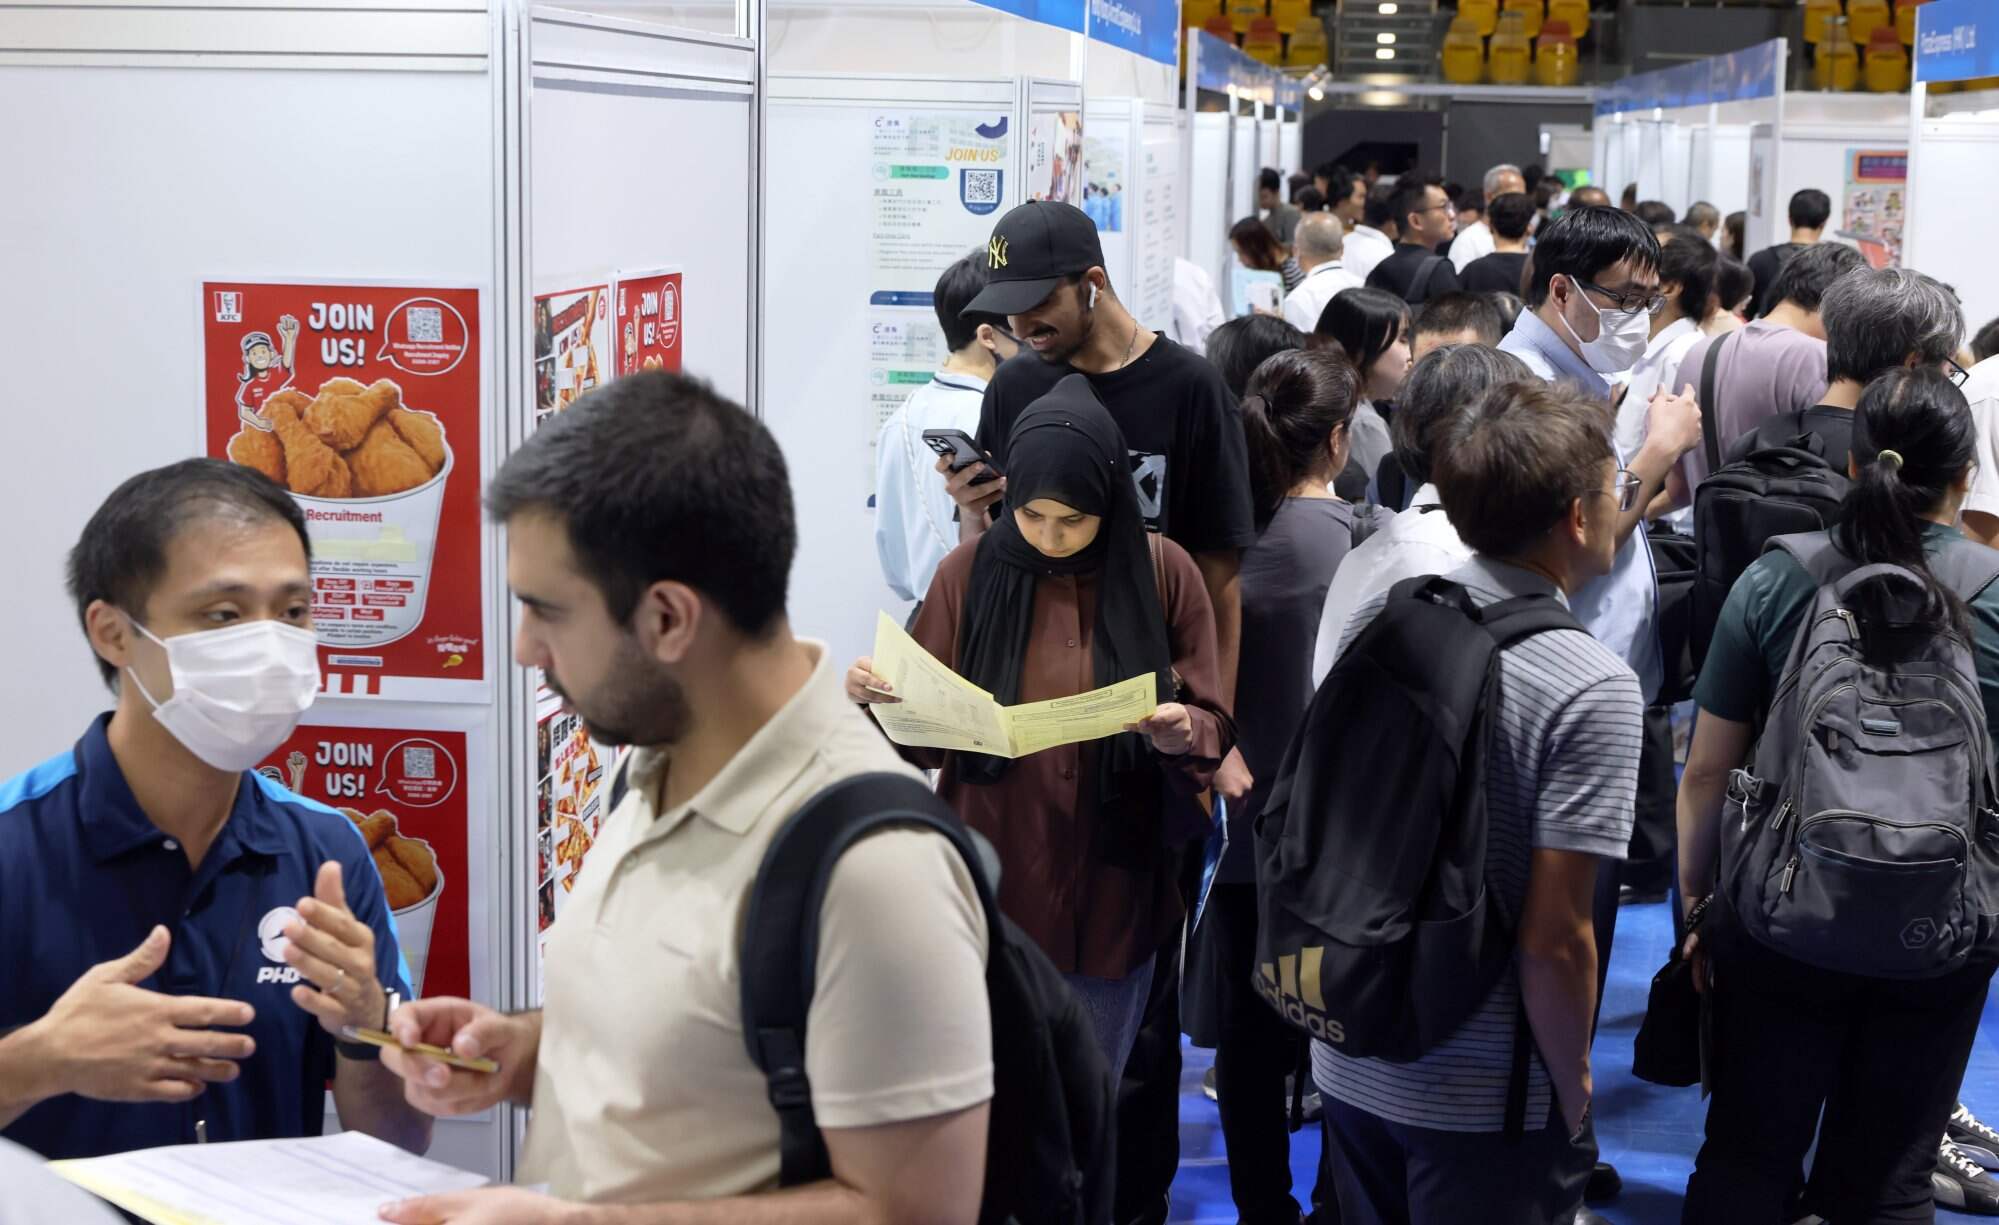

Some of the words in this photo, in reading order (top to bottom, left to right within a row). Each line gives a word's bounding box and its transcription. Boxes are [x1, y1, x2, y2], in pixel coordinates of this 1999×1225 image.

[945, 148, 977, 161] JOIN
[980, 149, 999, 162] US
[988, 235, 1008, 269] NY
[641, 292, 657, 316] JOIN
[220, 313, 238, 321] KFC
[308, 302, 374, 331] JOIN
[321, 338, 365, 366] US!
[306, 509, 382, 523] Recruitment
[315, 742, 373, 766] JOIN
[326, 773, 365, 797] US!
[257, 966, 301, 984] PHD
